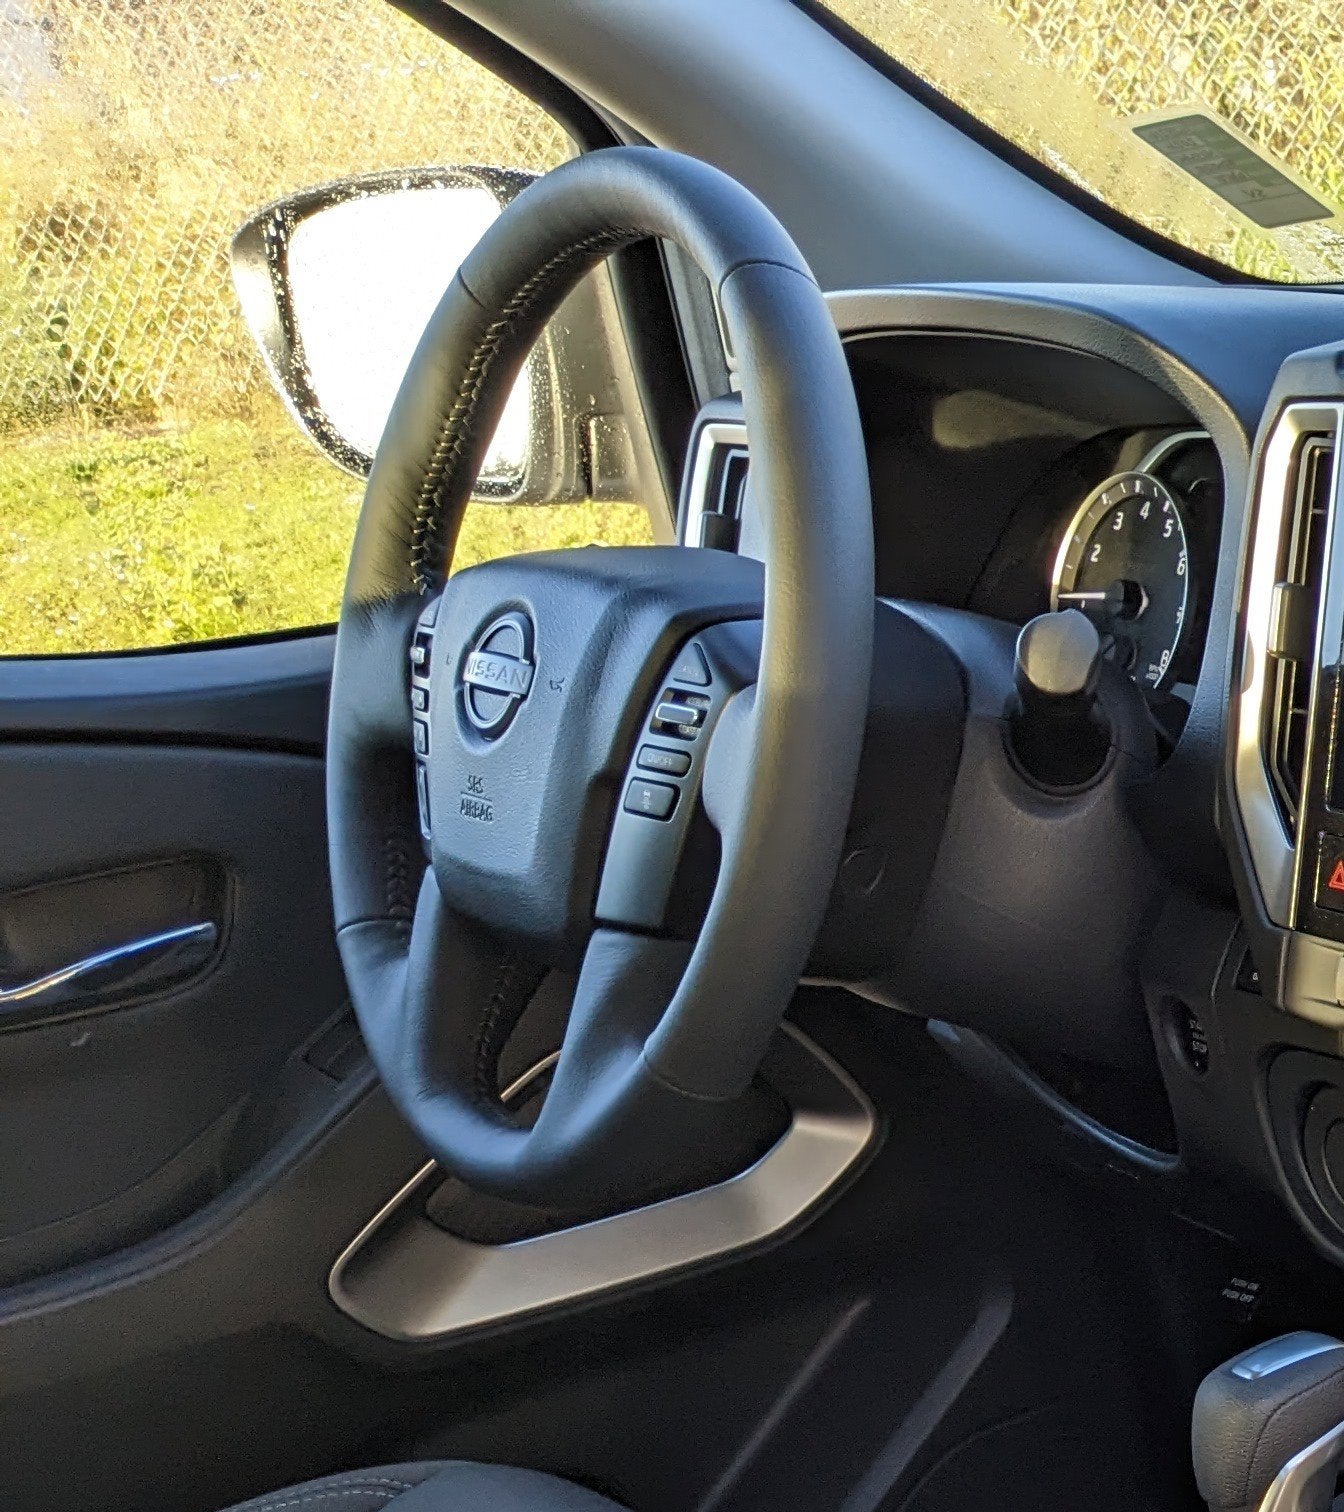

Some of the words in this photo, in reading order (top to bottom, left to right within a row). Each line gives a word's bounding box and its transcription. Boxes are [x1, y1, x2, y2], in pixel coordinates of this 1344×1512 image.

[1140, 501, 1150, 520] 4
[1114, 511, 1124, 531] 3
[1163, 518, 1175, 538] 5
[1091, 544, 1101, 563] 2
